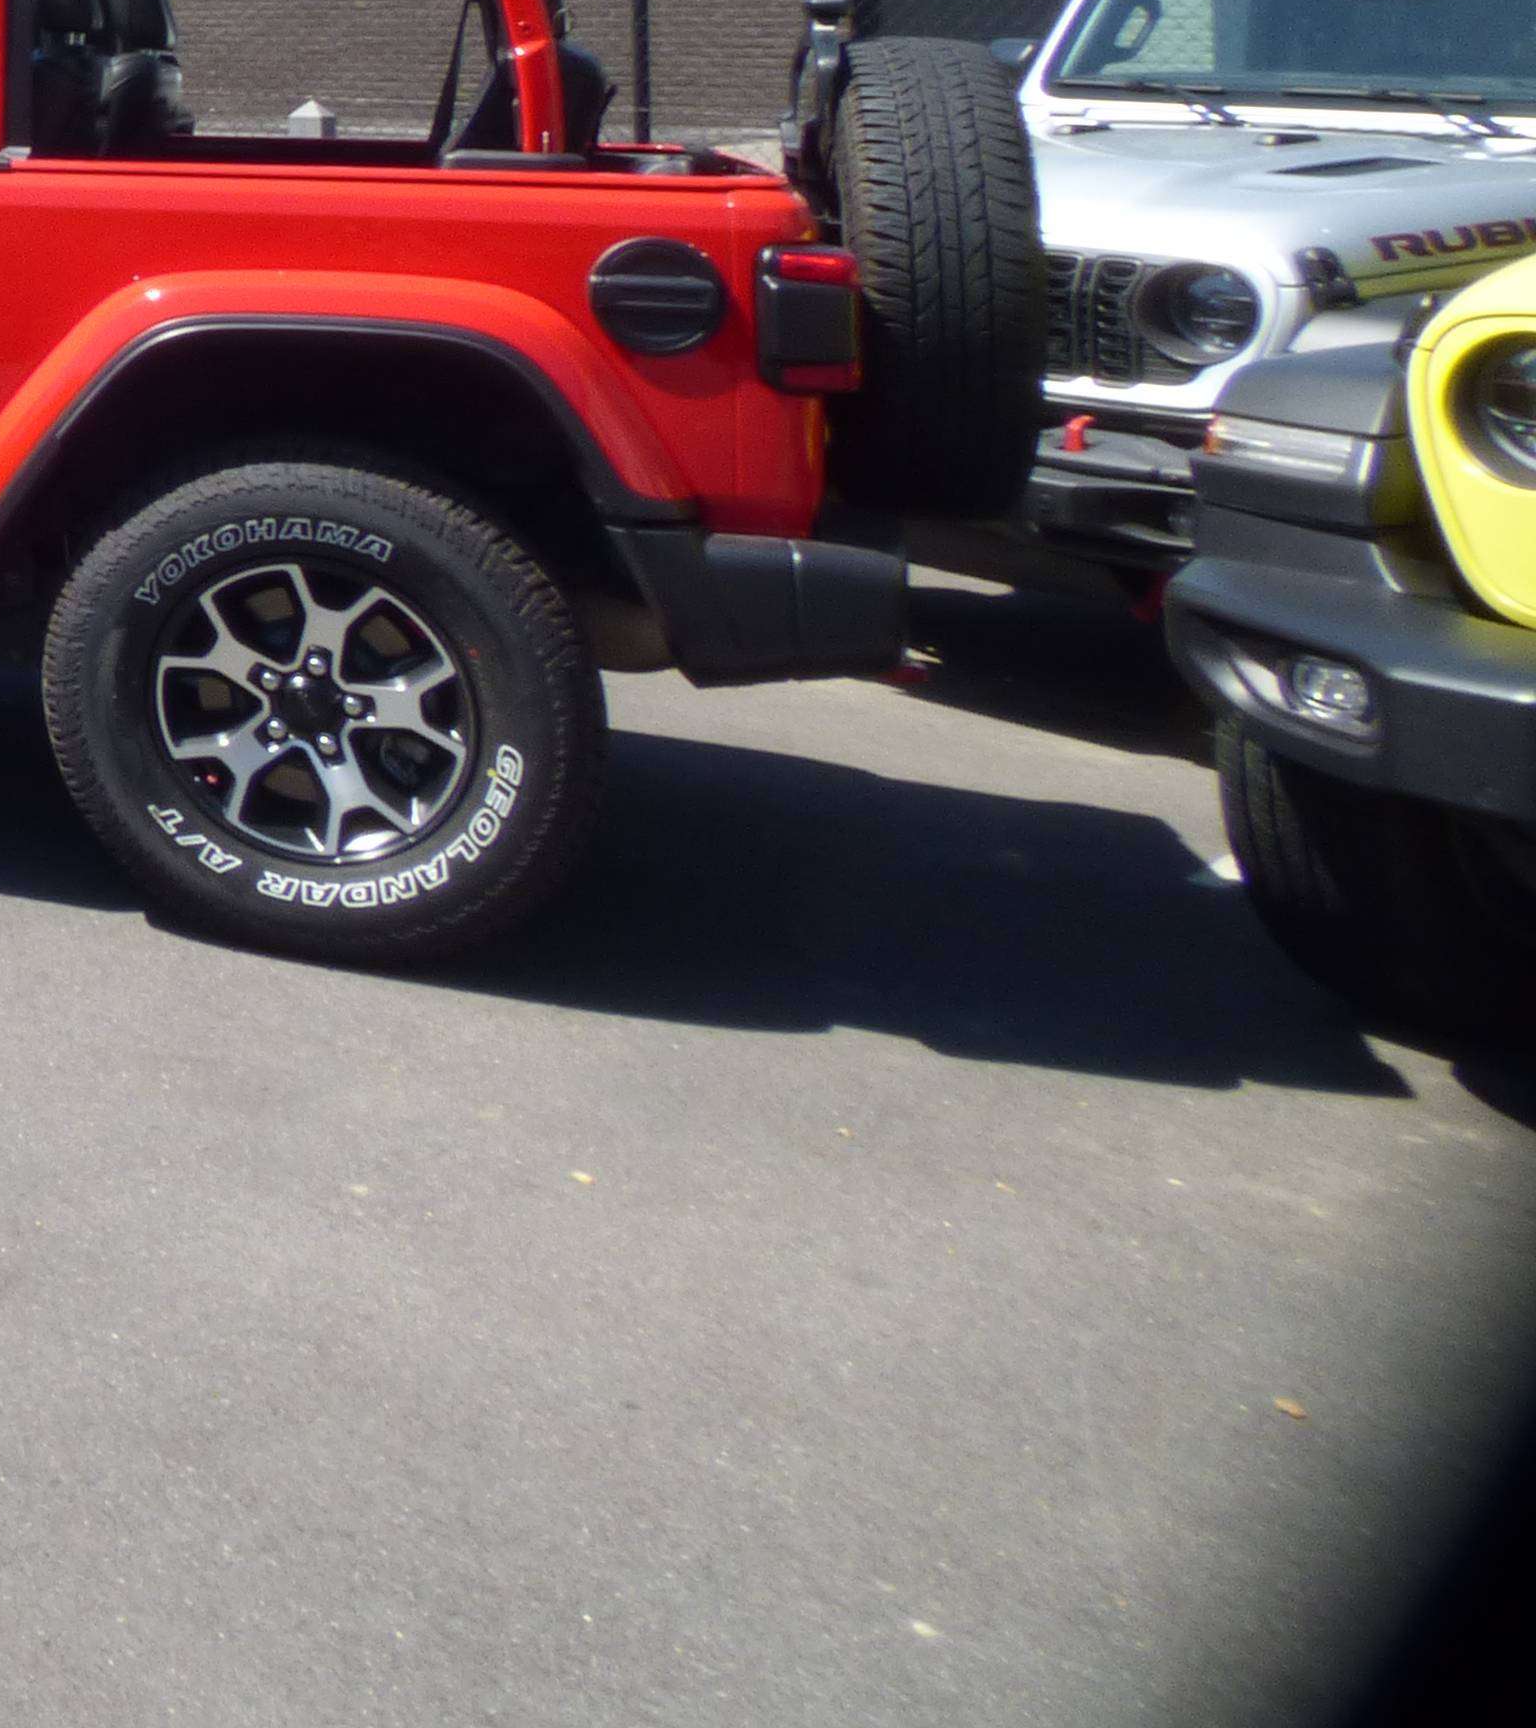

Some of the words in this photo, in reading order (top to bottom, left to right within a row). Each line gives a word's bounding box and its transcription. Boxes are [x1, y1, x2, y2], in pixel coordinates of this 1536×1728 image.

[135, 517, 393, 605] YOKOHAMA
[147, 803, 243, 874] A/T
[256, 743, 524, 908] GEOLANDAR
